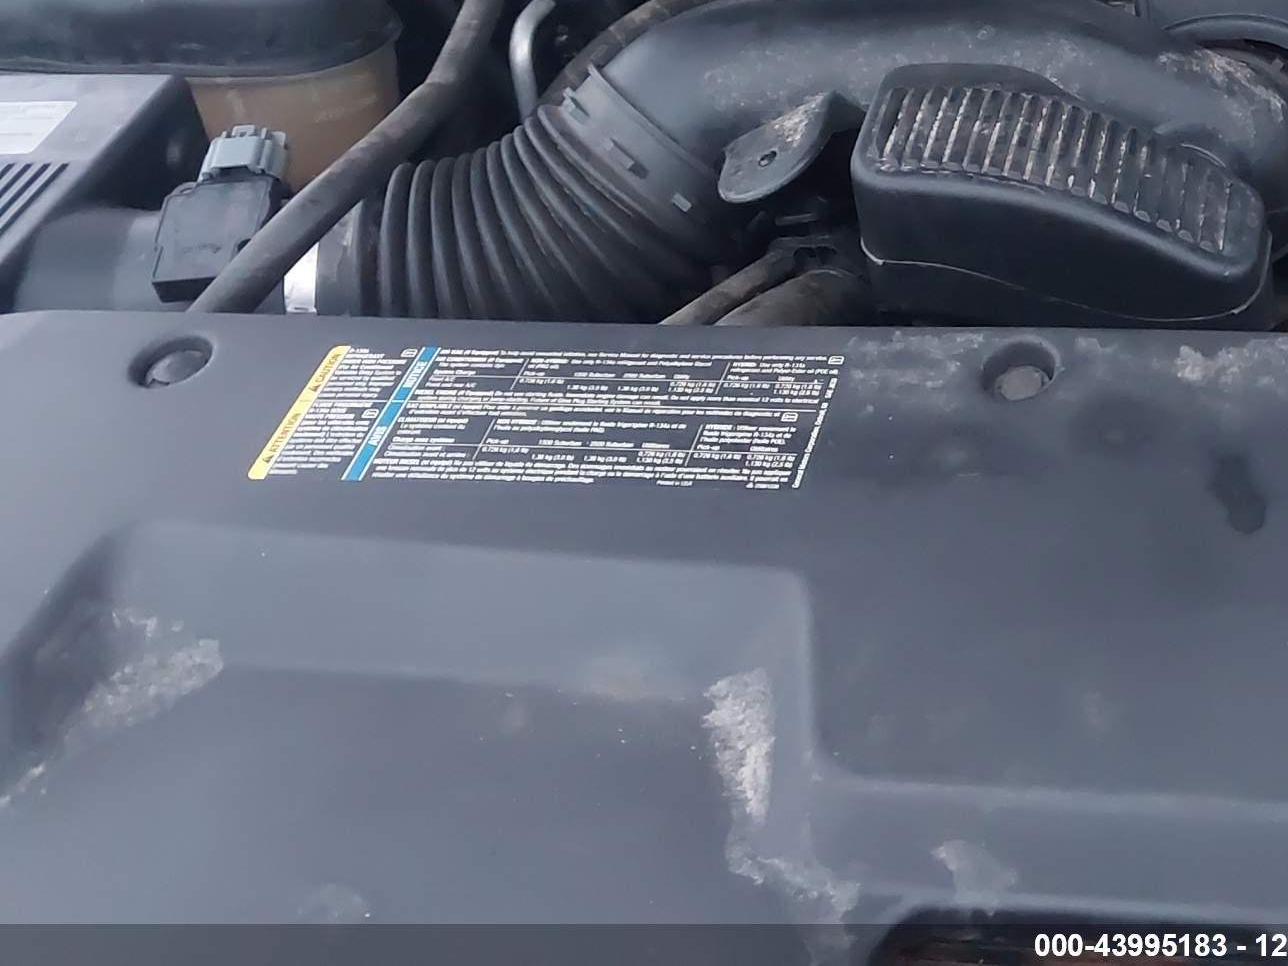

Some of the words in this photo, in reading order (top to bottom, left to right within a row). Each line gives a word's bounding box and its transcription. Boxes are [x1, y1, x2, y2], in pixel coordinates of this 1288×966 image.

[316, 353, 342, 383] CAUTION
[402, 361, 427, 387] NOTICE
[269, 412, 301, 453] ATTENTION
[368, 425, 387, 446] AVIS
